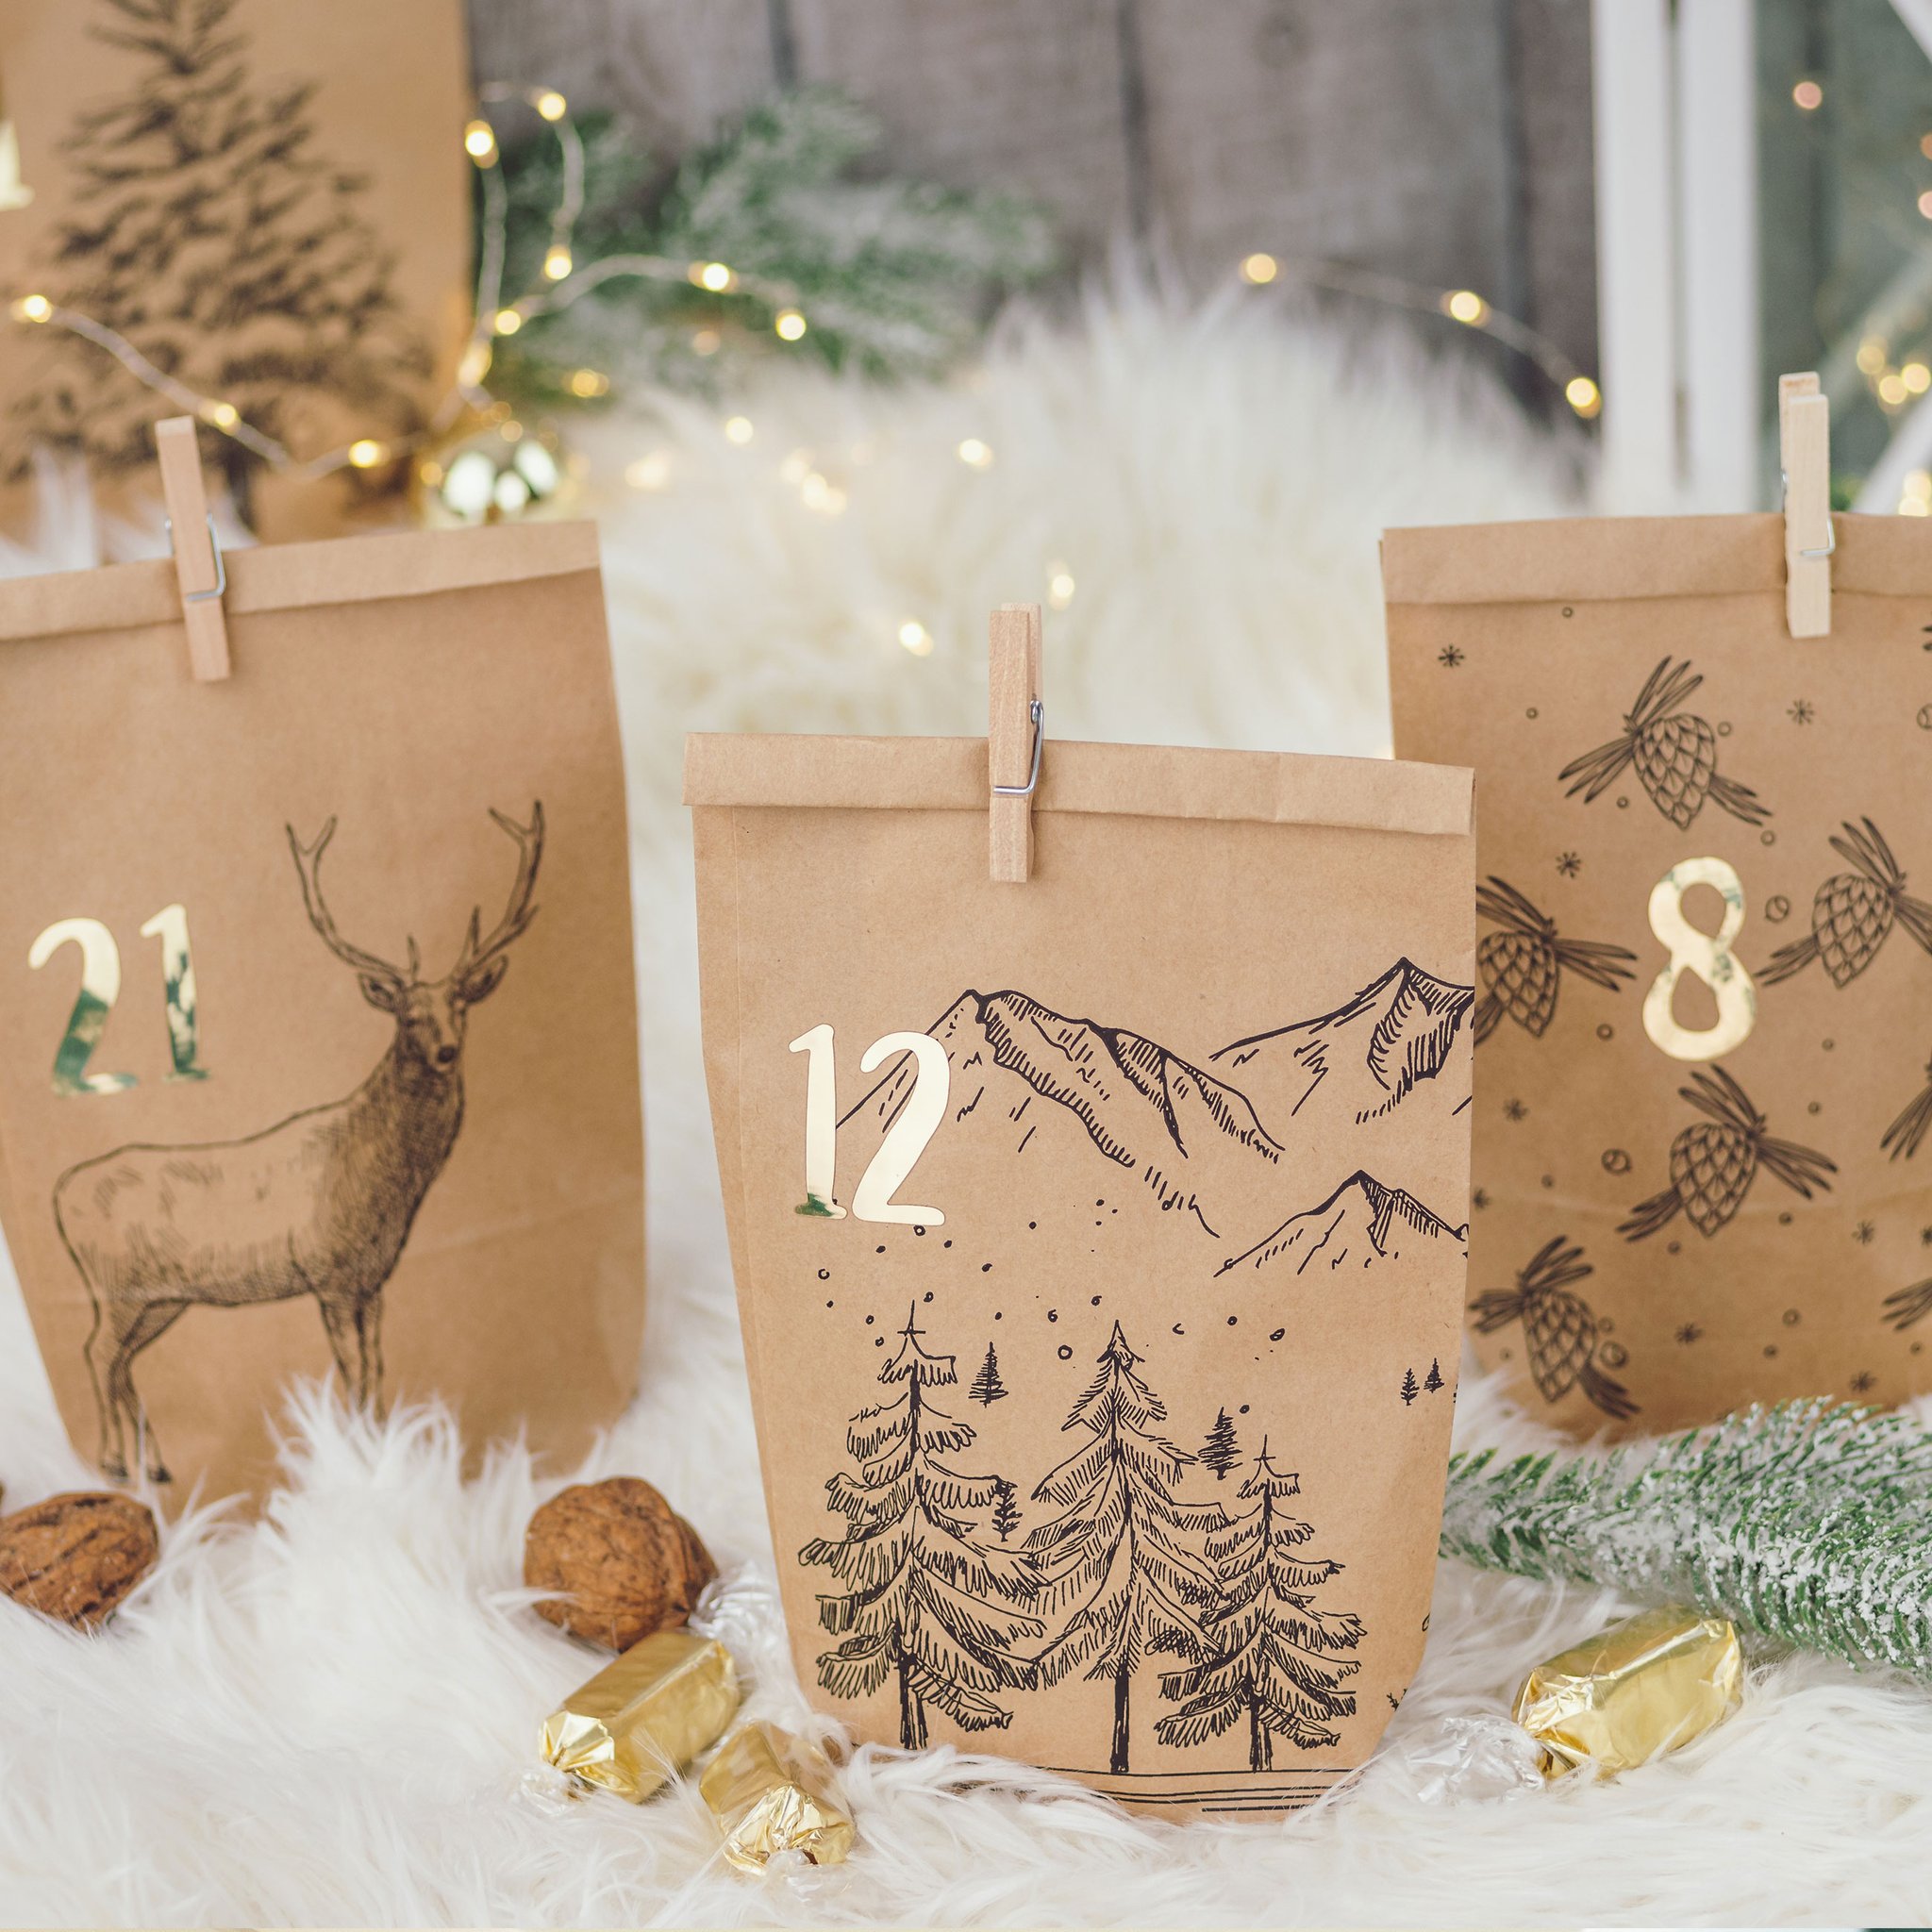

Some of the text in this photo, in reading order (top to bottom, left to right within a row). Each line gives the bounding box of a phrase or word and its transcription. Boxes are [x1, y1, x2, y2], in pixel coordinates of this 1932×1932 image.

[28, 903, 210, 1096] 21
[1642, 857, 1756, 1061] 8
[789, 1024, 951, 1225] 12
